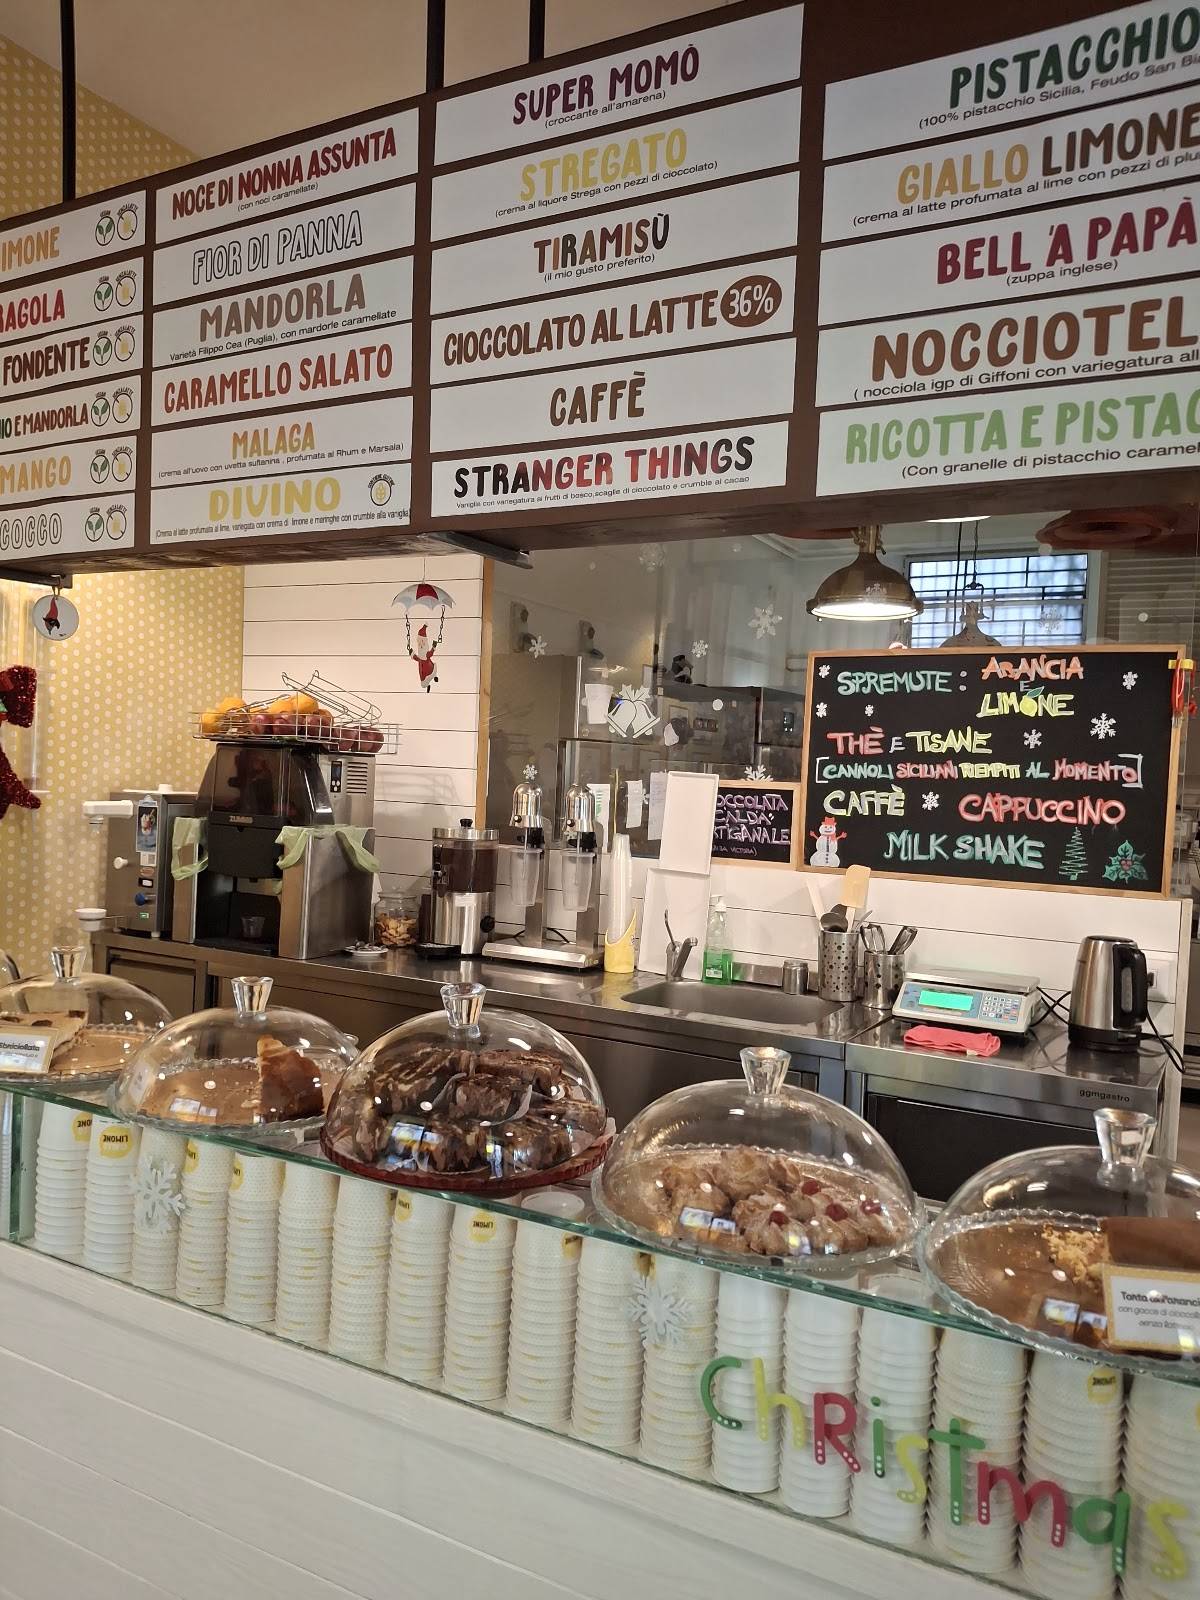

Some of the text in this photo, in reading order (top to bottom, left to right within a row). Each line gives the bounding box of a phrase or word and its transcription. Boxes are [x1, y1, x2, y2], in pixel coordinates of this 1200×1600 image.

[950, 6, 1200, 109] PISTACCHIO
[513, 43, 699, 125] SUPER MOMÒ
[918, 112, 959, 130] (100%
[963, 96, 1035, 120] pistacchio
[1039, 85, 1085, 102] Sicilia,
[1090, 70, 1140, 90] Feudo
[544, 89, 666, 128] (croccante all'amarena)
[172, 127, 396, 220] NOCE DI NONNA ASSUNTA
[520, 127, 688, 201] STREGATO
[897, 102, 1200, 205] GIALLO LIMONE
[255, 197, 270, 205] noci
[495, 160, 718, 219] (crema al liquore Strega con pezzi di cioccolato)
[852, 155, 1170, 227] (crema al latte profumata al lime con pezzi di
[192, 209, 363, 285] FIOR DI PANNA
[533, 212, 670, 274] TIRAMISÙ
[937, 231, 1032, 285] BELL
[1087, 196, 1197, 260] PAPÀ
[554, 268, 573, 280] mio
[575, 262, 604, 278] gusto
[606, 253, 655, 272] preferito)
[1006, 258, 1119, 286] (zuppa inglese)
[200, 273, 366, 342] MANDORLA
[443, 283, 775, 366] CIOCCOLATO AL LATTE 36%
[198, 345, 224, 356] Filippo
[225, 341, 242, 350] Cea
[280, 330, 297, 339] con
[341, 310, 397, 327] caramellate
[871, 296, 1199, 382] NOCCIOTEL
[3, 337, 90, 386] FONDENTE
[164, 343, 393, 414] CARAMELLO SALATO
[863, 381, 927, 398] nocciola
[930, 379, 955, 394] igp
[959, 374, 973, 387] di
[978, 367, 1030, 384] Giffoni
[1035, 365, 1067, 378] con
[1071, 353, 1173, 374] variegatura
[15, 415, 21, 436] E
[23, 403, 88, 435] MANDORLA
[549, 371, 646, 427] CAFFÈ
[231, 422, 316, 460] MALAGA
[336, 449, 359, 457] Rhum
[845, 408, 1008, 464] RICOTTA
[1020, 404, 1044, 449] E
[0, 455, 72, 495] MANGO
[454, 436, 755, 498] STRANGER THINGS
[631, 484, 671, 493] cioccolato
[723, 476, 750, 485] cacao
[901, 464, 939, 479] (Con
[943, 458, 1008, 475] granelle
[1013, 455, 1027, 467] di
[1032, 448, 1121, 469] pistacchio
[208, 476, 341, 522] DIVINO
[0, 513, 62, 550] COCCO
[837, 670, 952, 696] SPREMUTE
[981, 654, 1084, 680] ARANCIA
[826, 726, 885, 755] THÈ
[905, 726, 992, 754] TISANE
[895, 760, 958, 780] SICILIANI
[1025, 761, 1050, 779] AL
[824, 784, 1126, 825] CAFFÈ CAPPUCCINO
[883, 829, 1045, 869] MILK SHAKE
[103, 1134, 129, 1143] LIMONE
